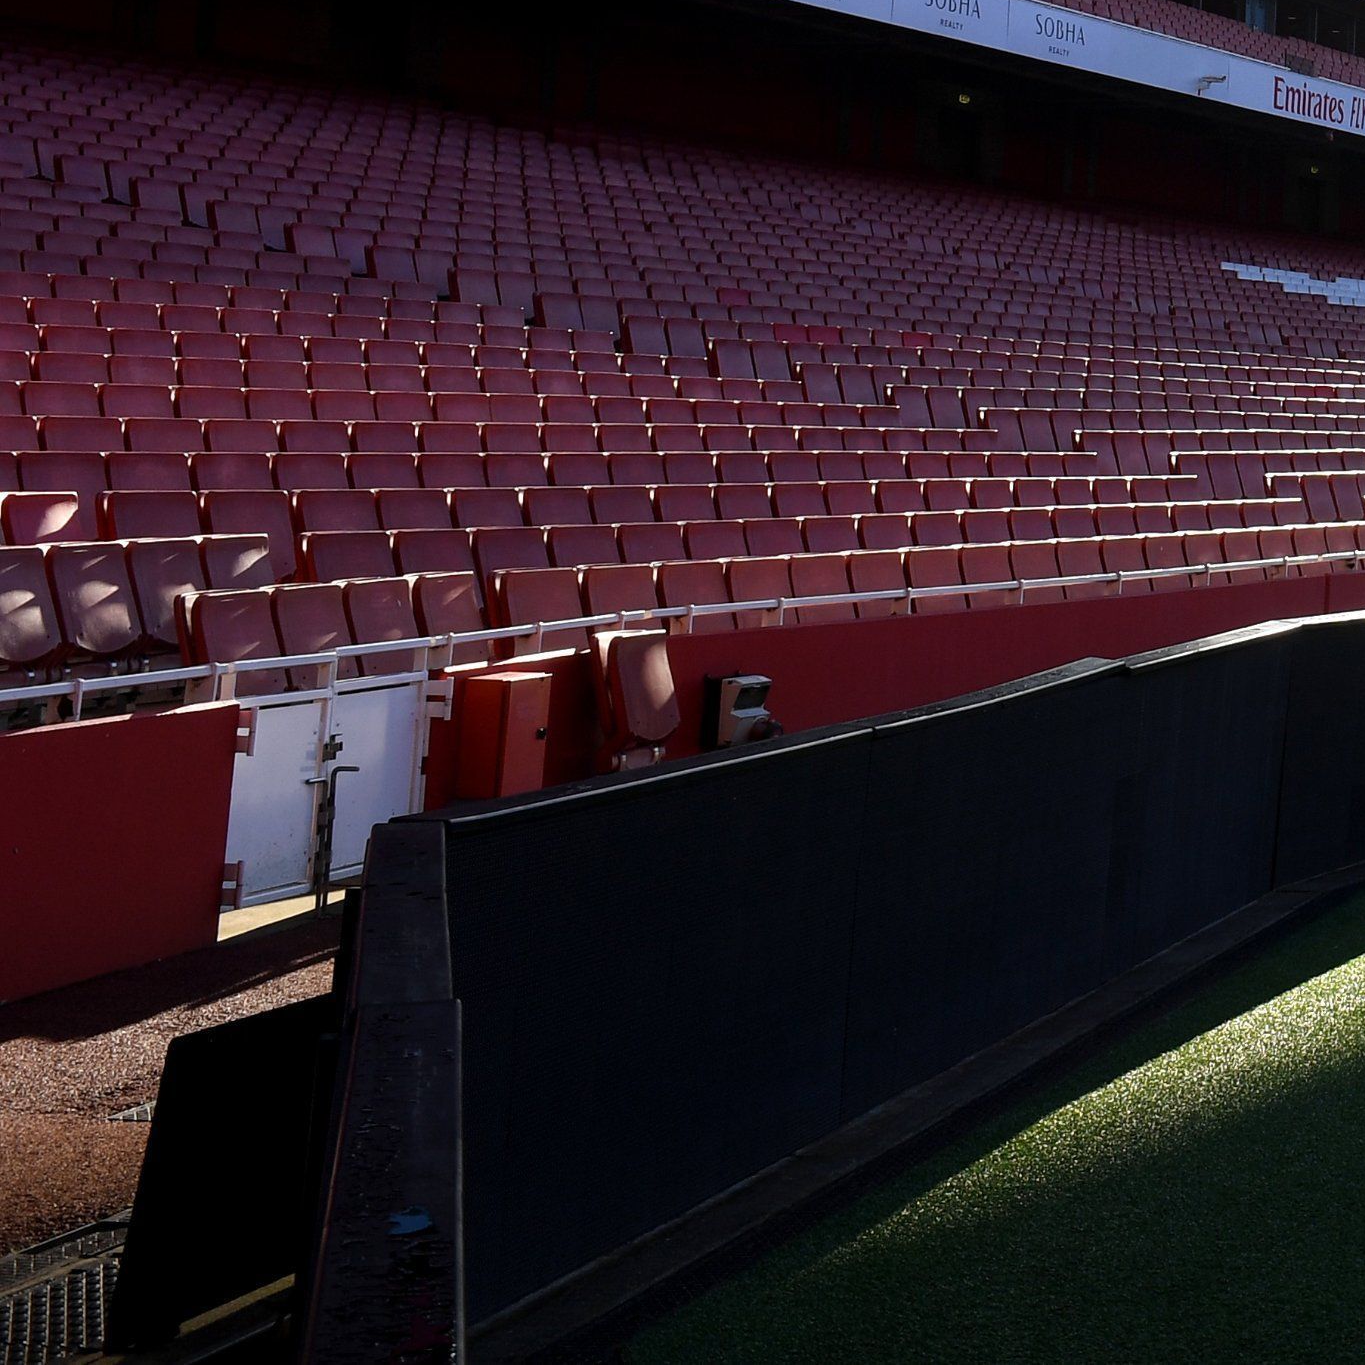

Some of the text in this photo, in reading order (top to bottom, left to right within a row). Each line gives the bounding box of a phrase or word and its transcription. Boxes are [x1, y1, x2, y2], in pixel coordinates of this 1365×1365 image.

[940, 19, 964, 31] REALTY
[1036, 13, 1086, 46] SOBHA
[1049, 46, 1070, 57] REALTY
[1274, 76, 1345, 124] Emirates
